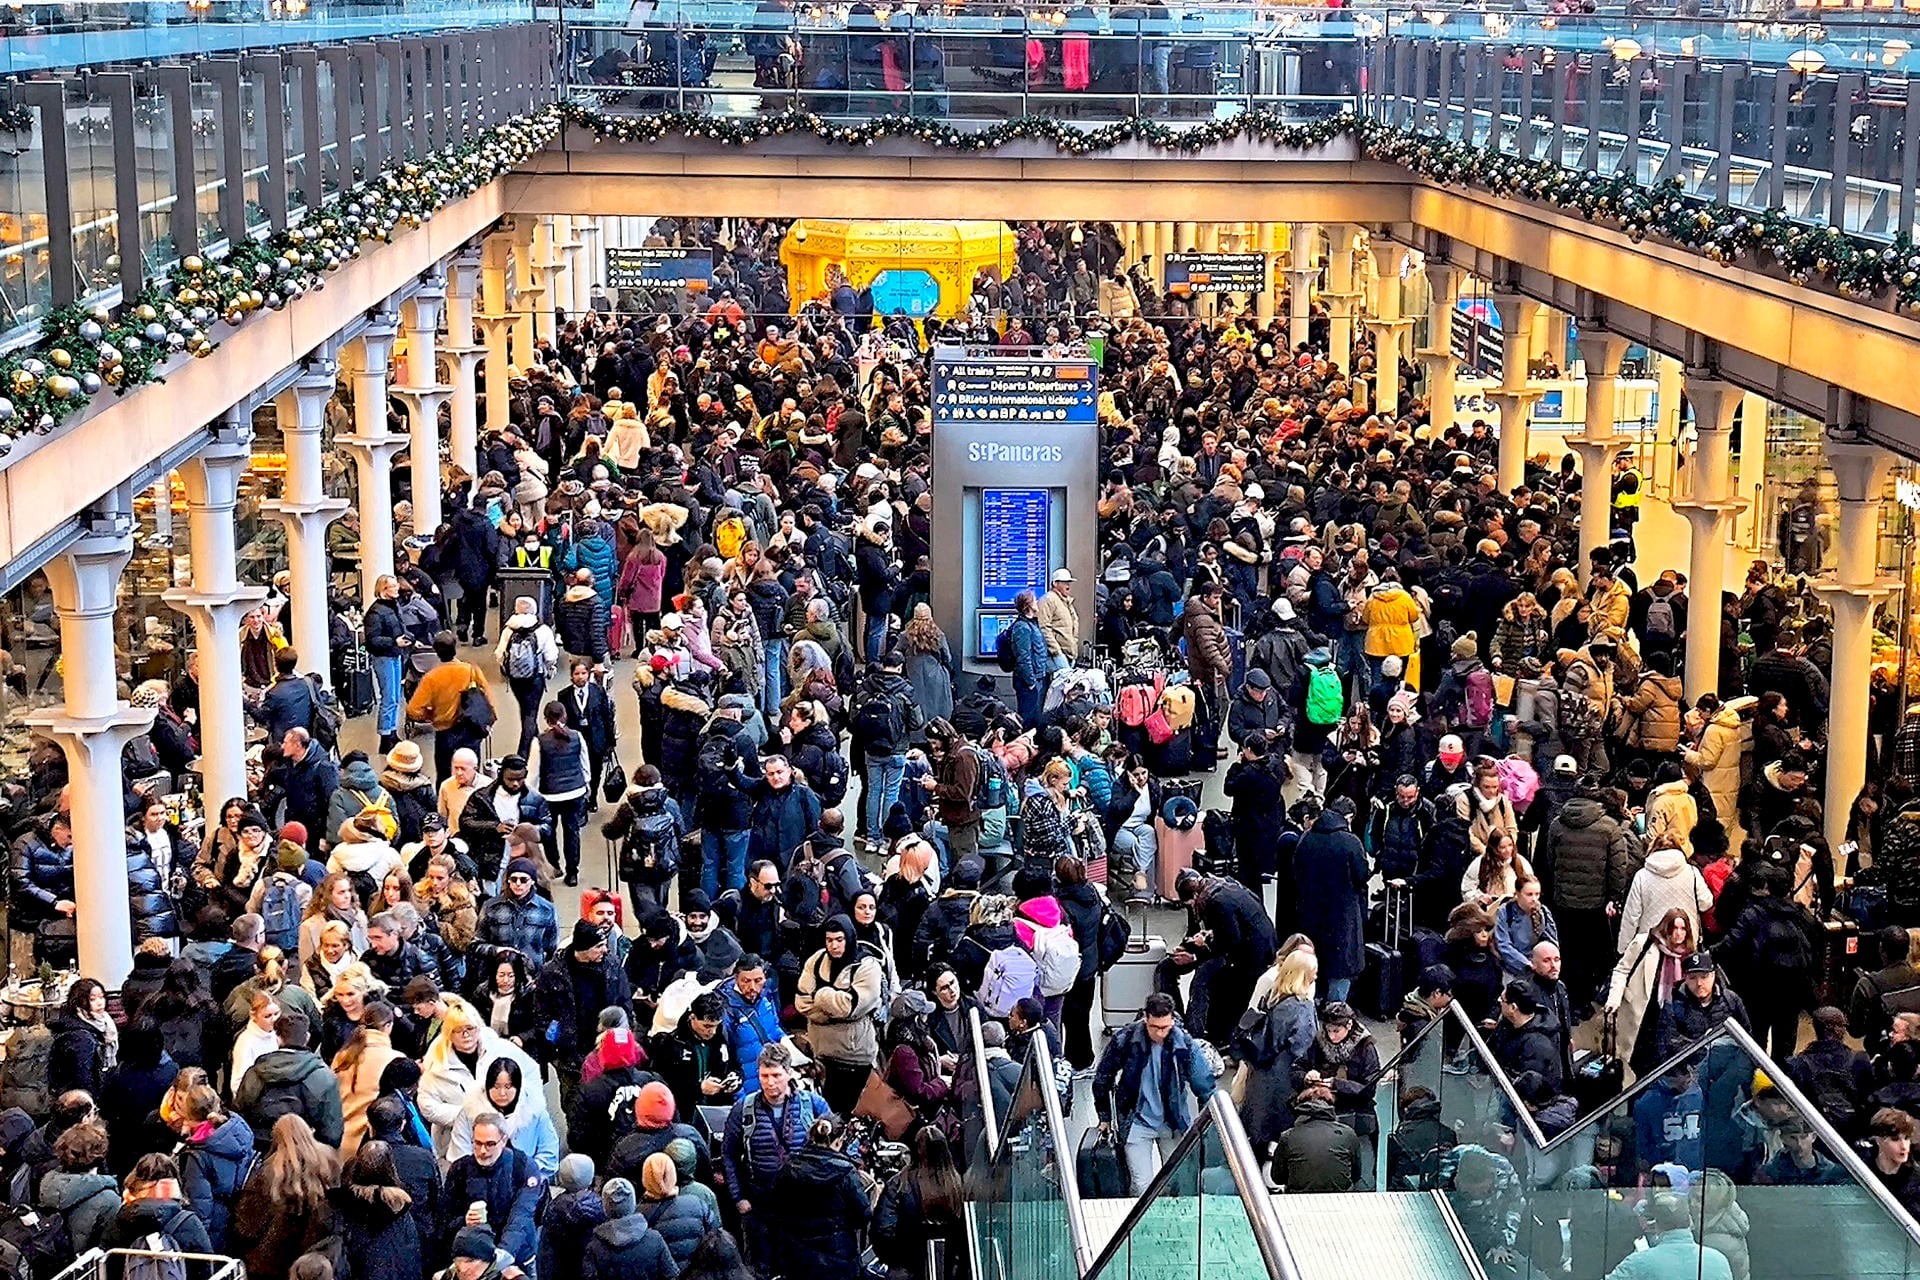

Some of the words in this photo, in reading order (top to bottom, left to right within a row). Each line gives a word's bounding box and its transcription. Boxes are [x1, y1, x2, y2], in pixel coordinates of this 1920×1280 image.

[952, 366, 966, 376] All
[967, 366, 994, 376] trains
[990, 381, 1026, 392] Départs
[1027, 381, 1078, 392] Departures
[958, 395, 988, 405] Billets
[989, 395, 1047, 405] International
[1048, 395, 1079, 405] tickets
[987, 442, 1063, 462] Pancras
